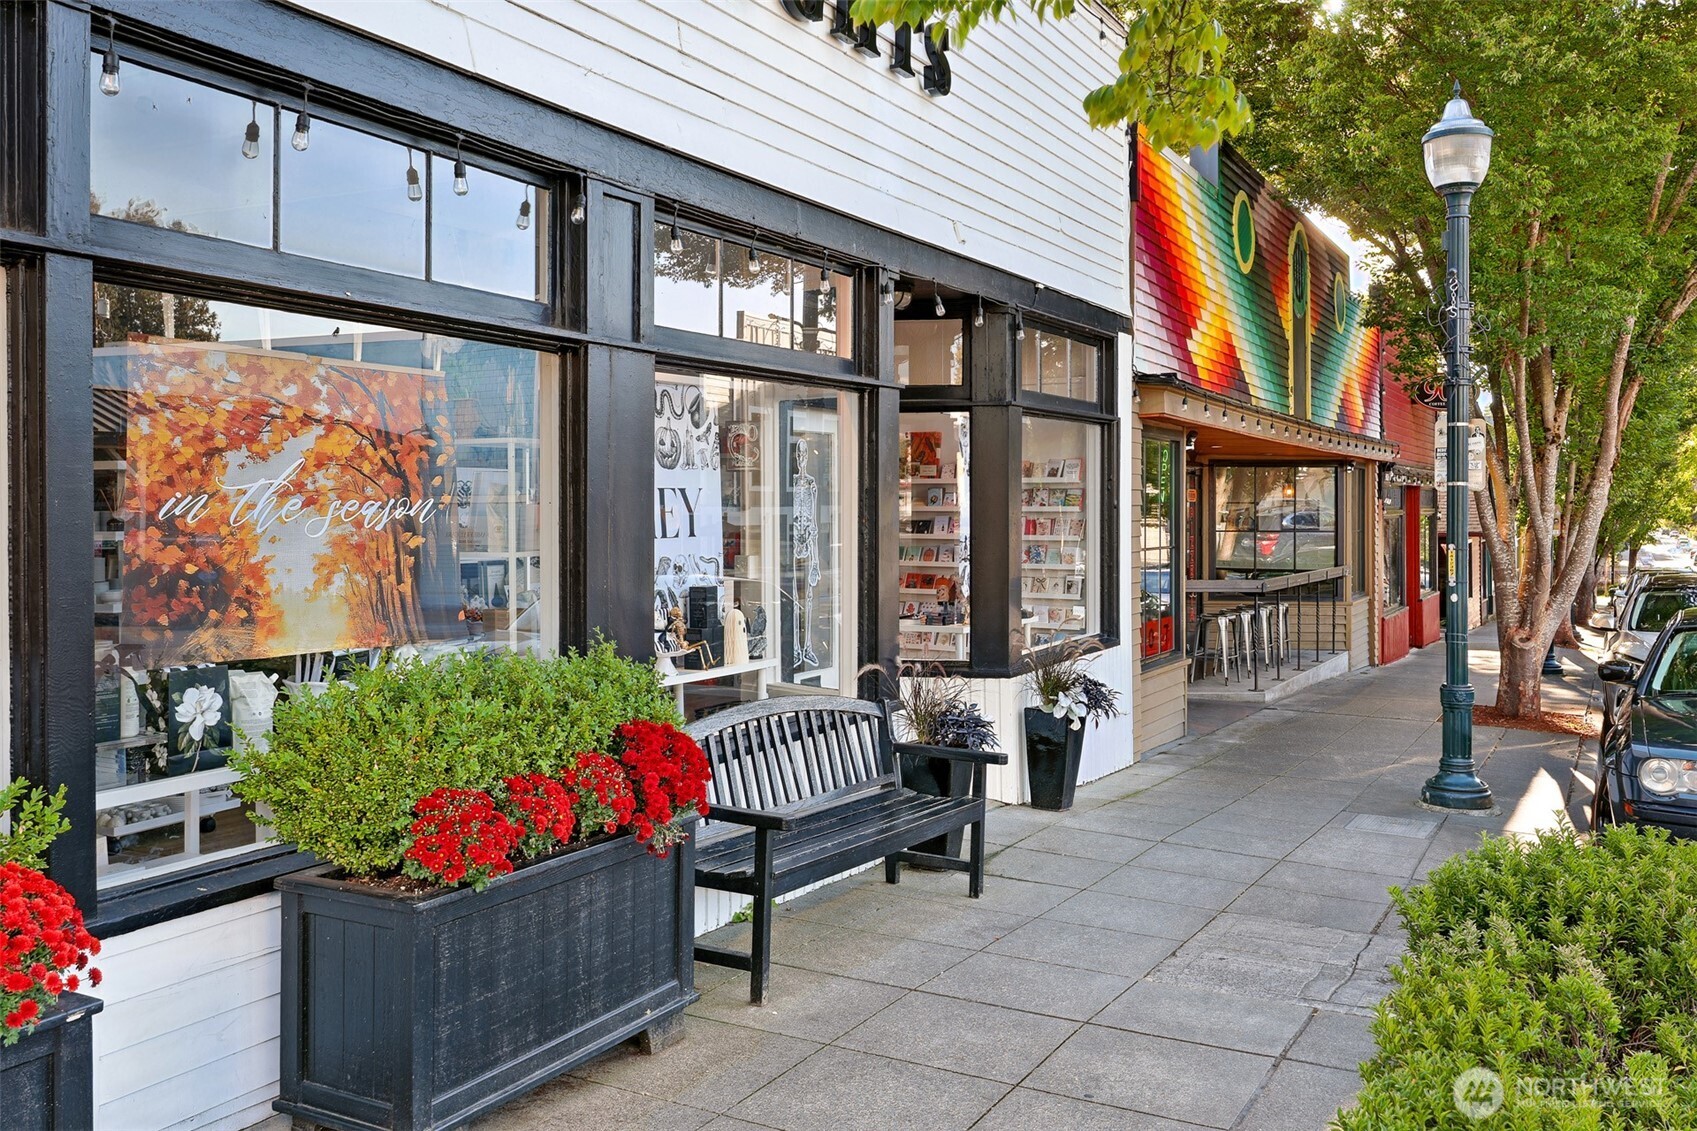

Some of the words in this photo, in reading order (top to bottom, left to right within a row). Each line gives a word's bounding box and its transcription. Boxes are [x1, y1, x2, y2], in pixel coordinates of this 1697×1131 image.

[158, 492, 210, 524] in
[215, 458, 306, 534] the
[304, 496, 437, 538] season
[654, 487, 703, 539] EY
